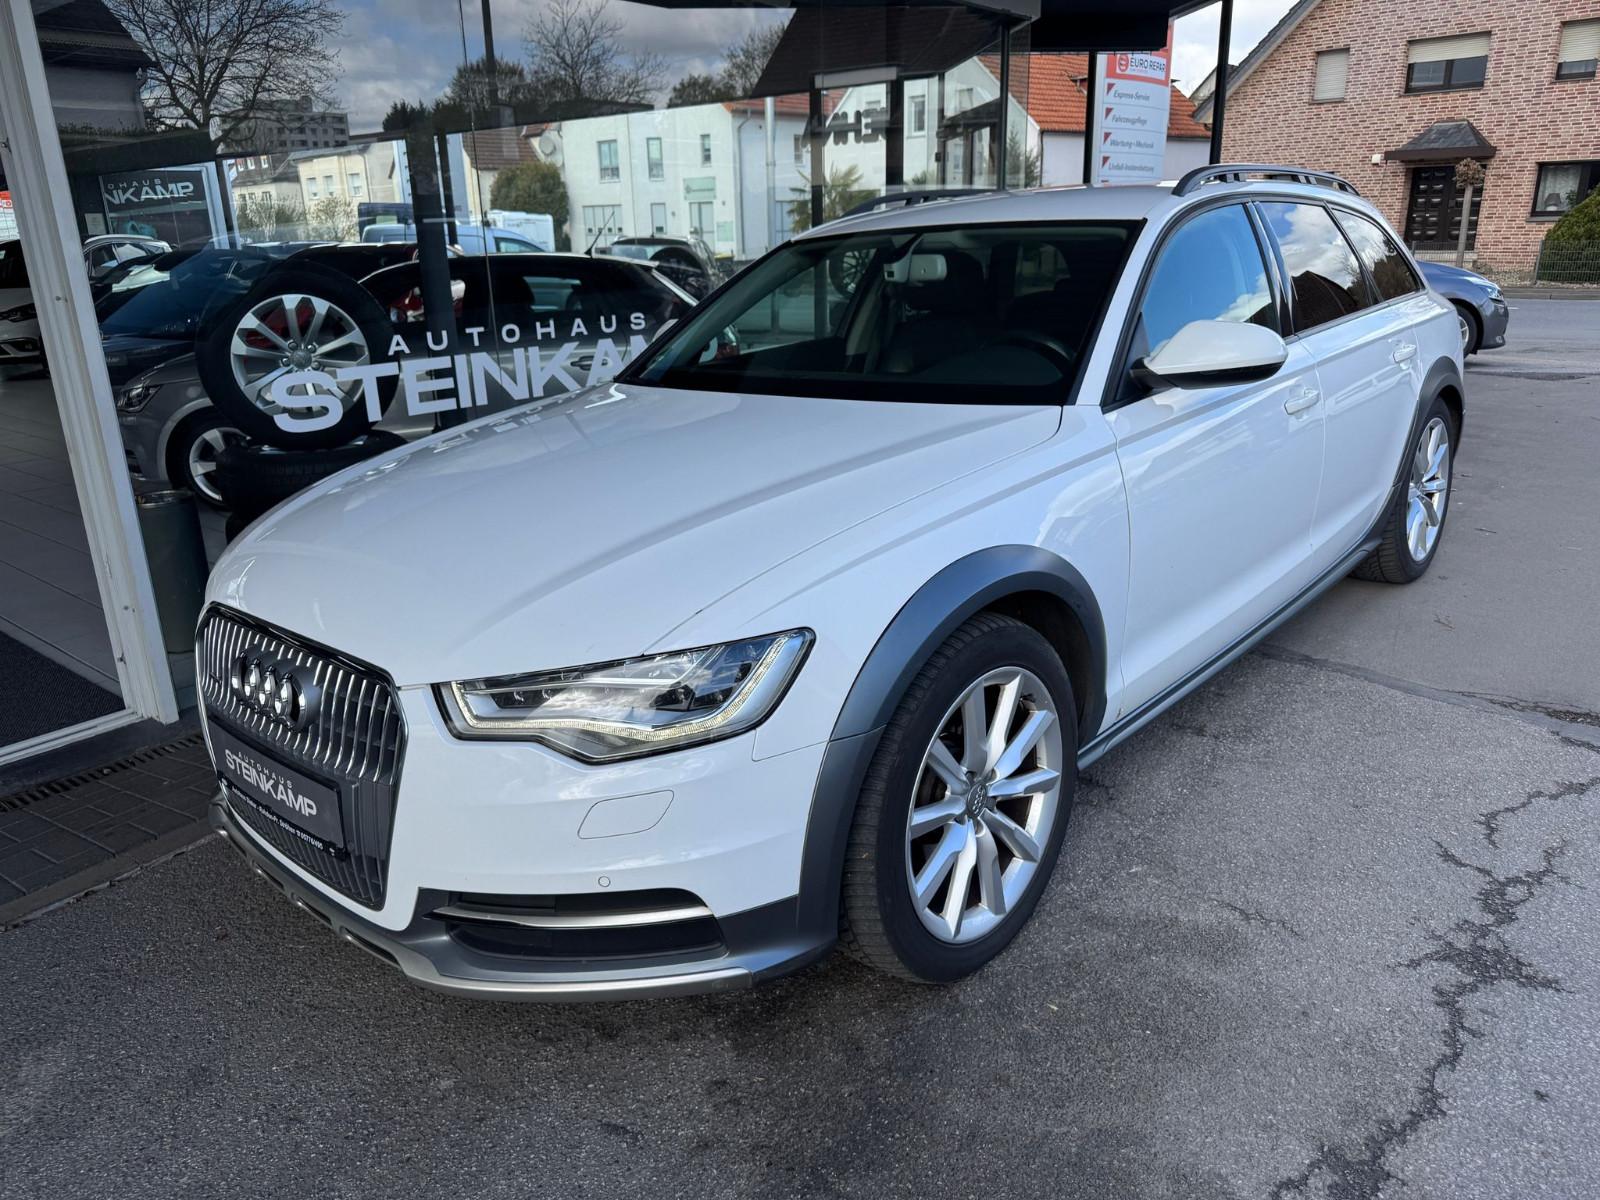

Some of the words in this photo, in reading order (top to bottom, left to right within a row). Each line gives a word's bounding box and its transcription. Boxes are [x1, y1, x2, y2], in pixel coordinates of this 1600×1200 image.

[1130, 57, 1149, 69] EURO
[1149, 60, 1166, 72] REPAR
[388, 312, 646, 357] AUTOHAUS
[224, 749, 317, 817] STEINKAMP
[238, 751, 293, 789] AUTOHAUS
